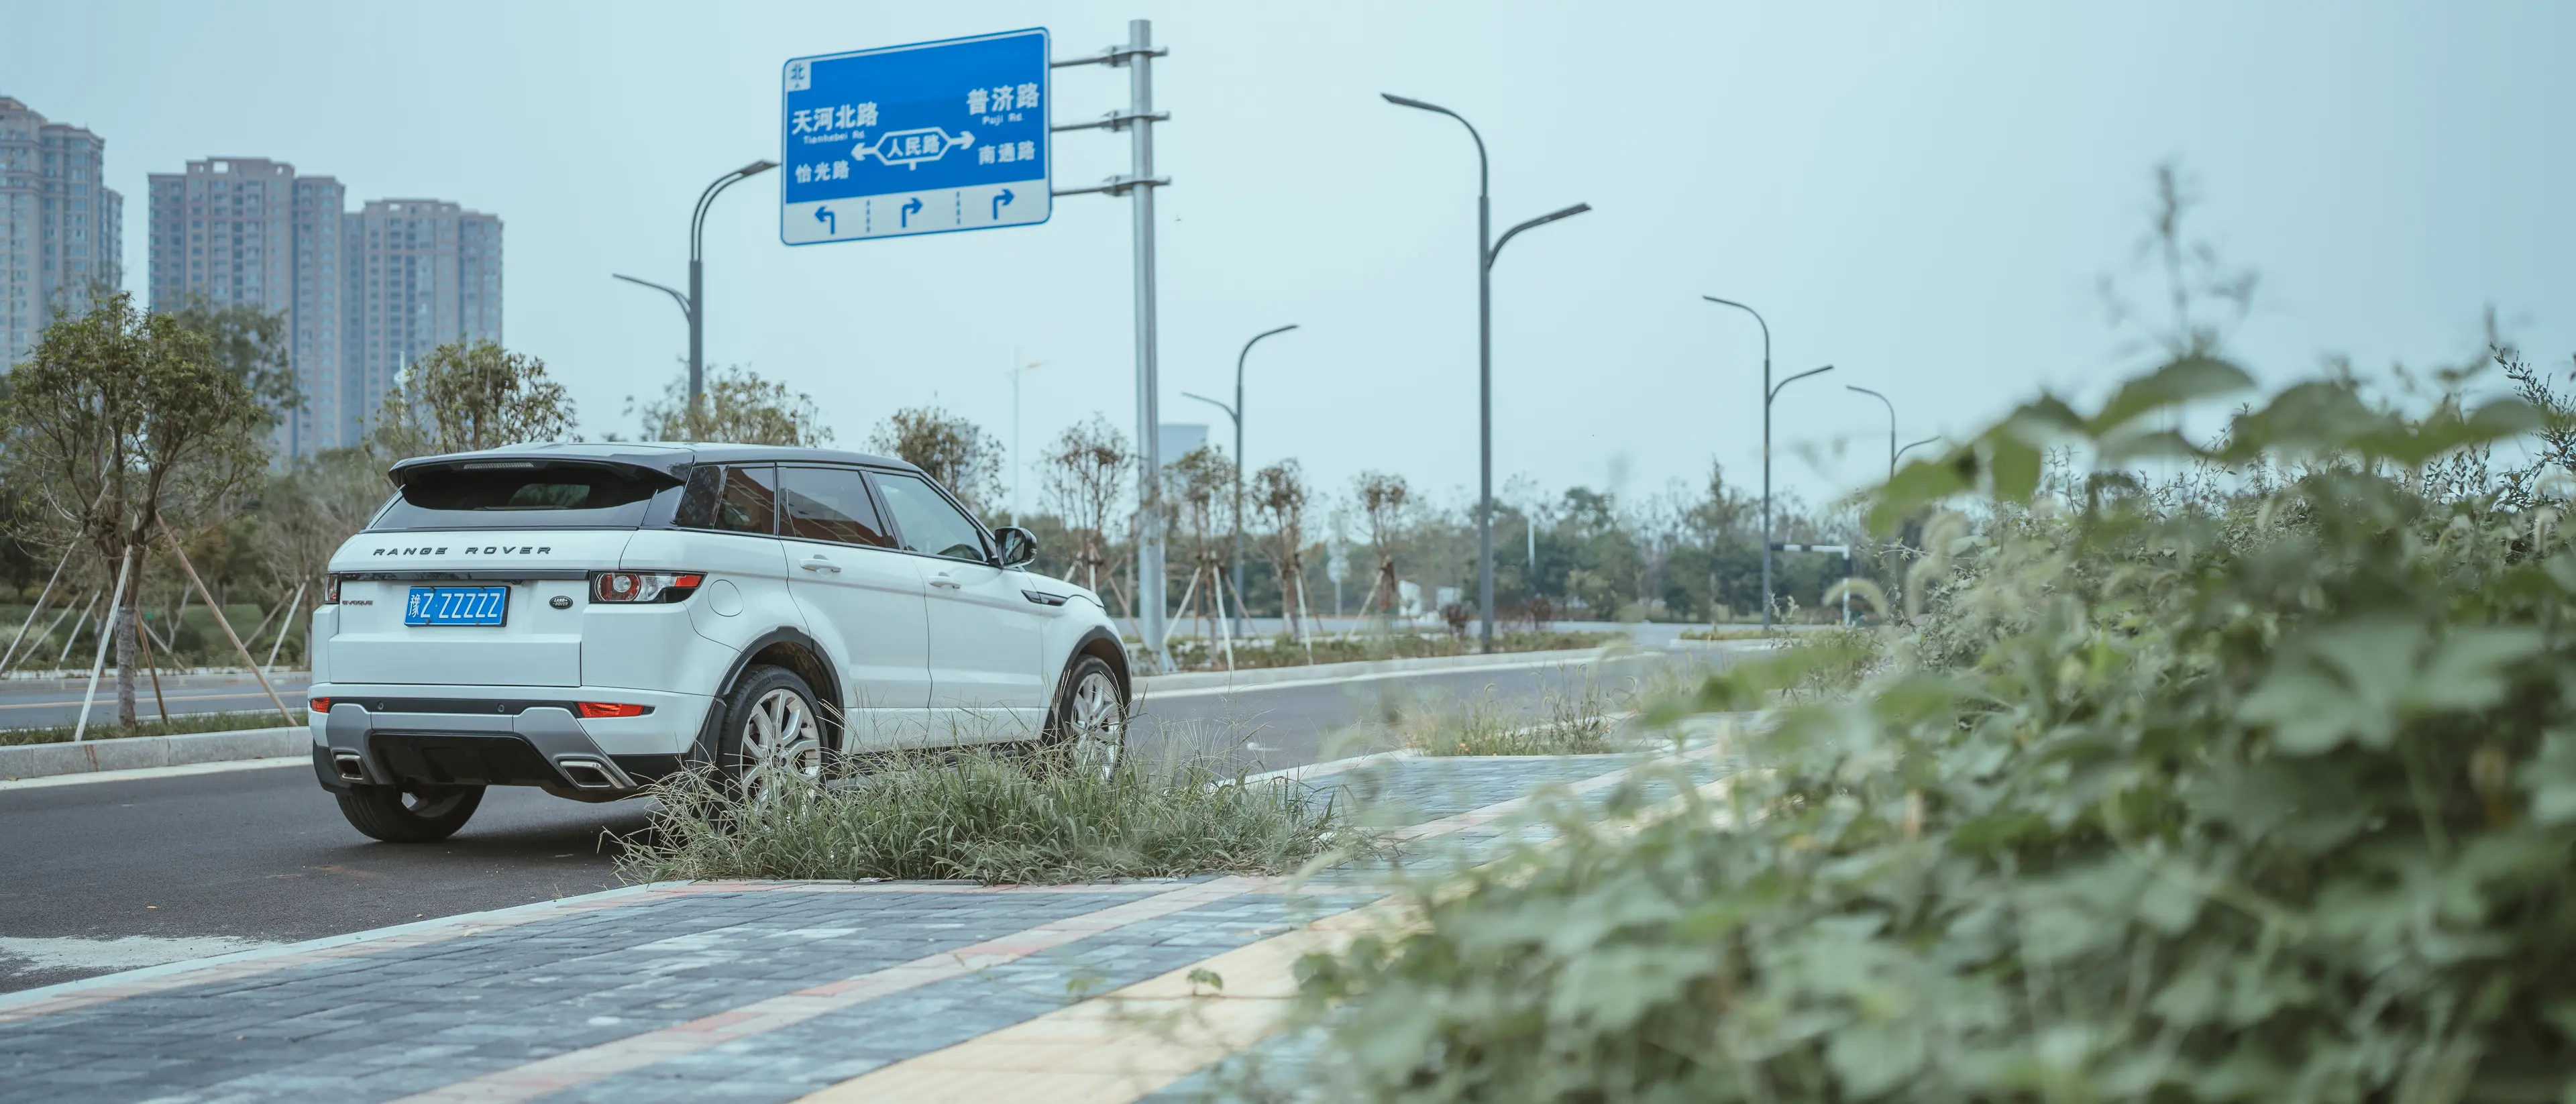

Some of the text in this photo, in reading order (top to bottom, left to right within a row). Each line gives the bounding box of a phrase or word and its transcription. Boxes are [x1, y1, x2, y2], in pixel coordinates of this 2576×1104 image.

[791, 63, 805, 80] 北
[966, 82, 1040, 115] 普济路
[792, 101, 879, 135] 天河北路
[981, 114, 1004, 126] Puji
[887, 134, 939, 158] 人民路
[978, 140, 1035, 166] 南通路
[373, 546, 551, 556] RANGE ROVER
